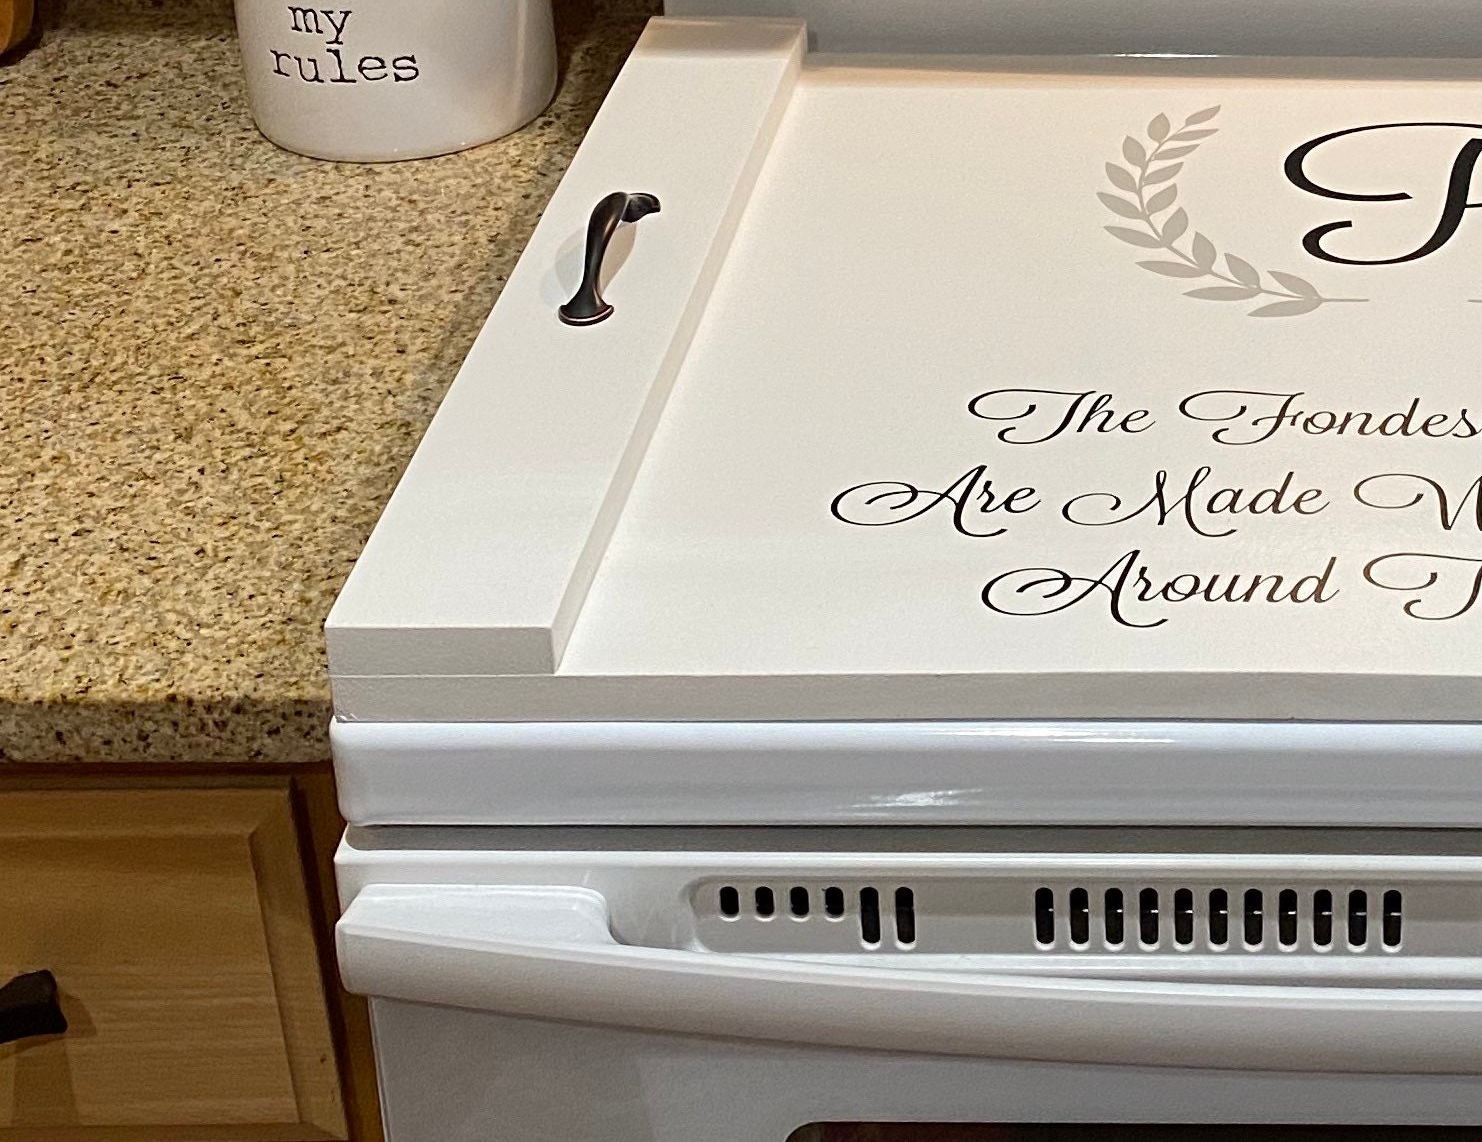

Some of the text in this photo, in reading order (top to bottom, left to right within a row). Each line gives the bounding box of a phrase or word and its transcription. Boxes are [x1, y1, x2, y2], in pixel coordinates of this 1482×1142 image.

[287, 5, 352, 45] my
[269, 48, 420, 84] rules
[966, 388, 1156, 445] The
[829, 464, 1042, 538] Are
[1061, 465, 1330, 538] Made
[980, 549, 1339, 629] Around
